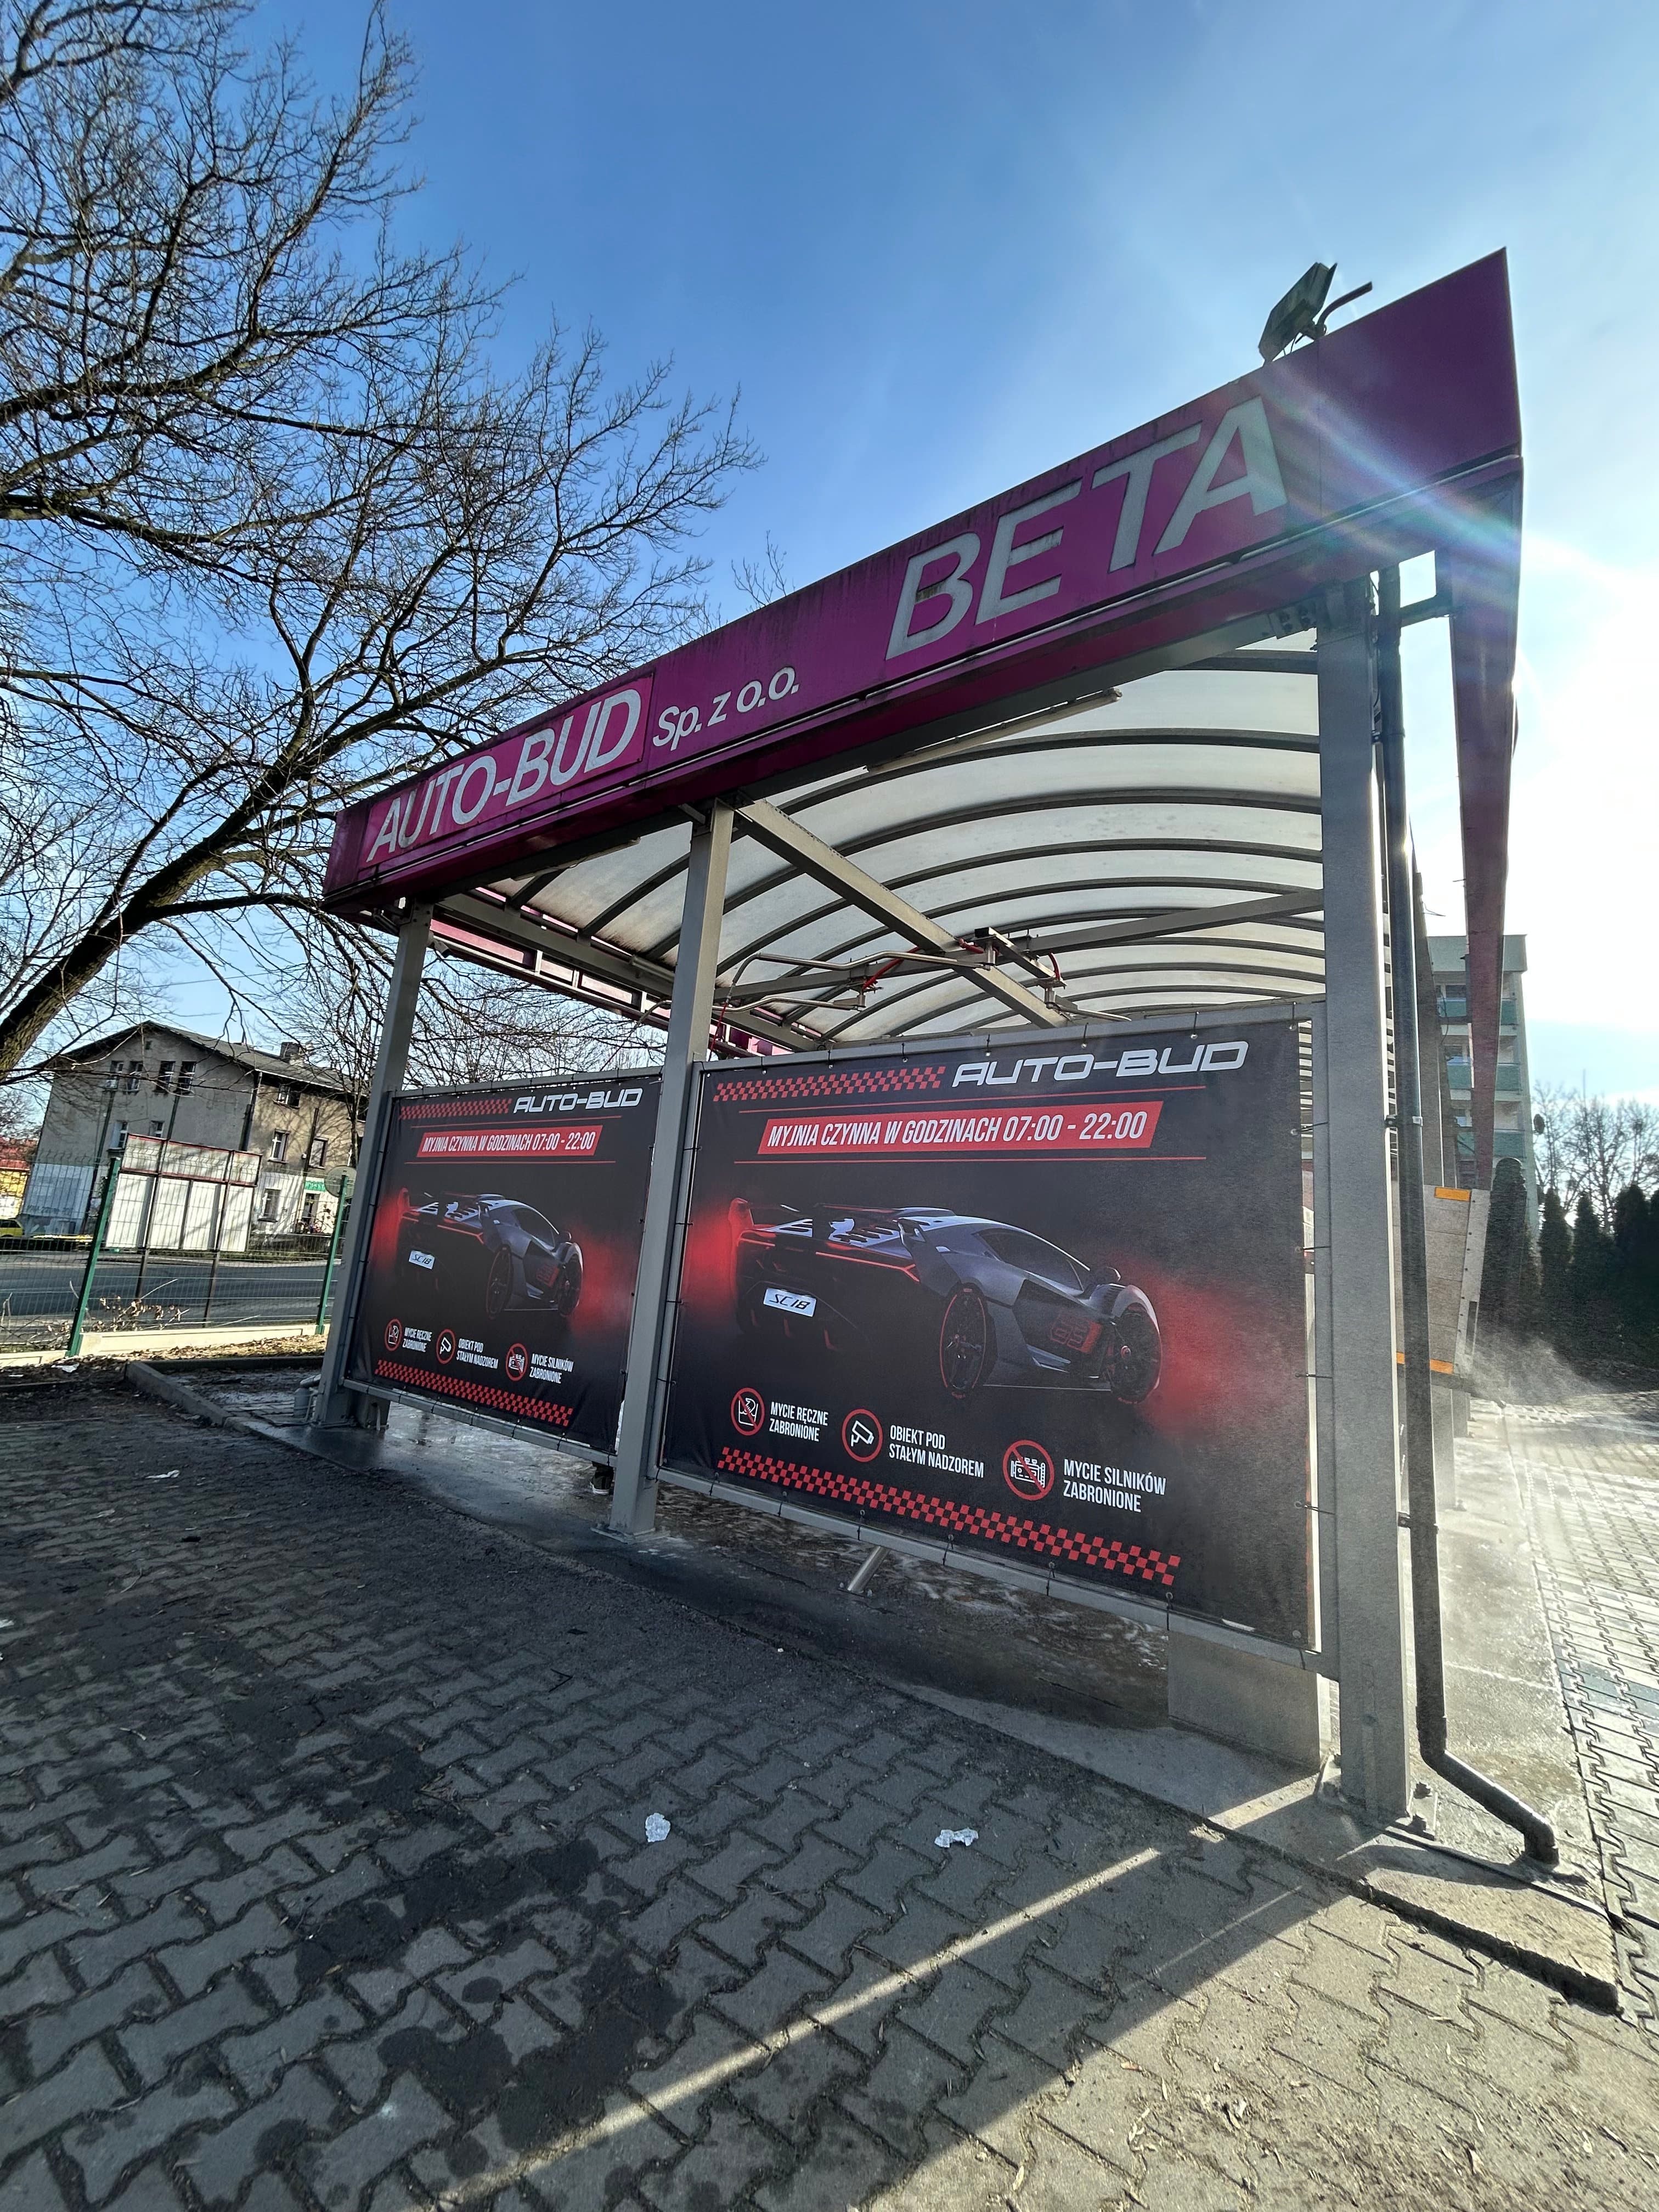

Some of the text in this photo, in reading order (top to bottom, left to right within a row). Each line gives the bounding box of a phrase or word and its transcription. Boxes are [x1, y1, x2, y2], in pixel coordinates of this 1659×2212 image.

[885, 396, 1288, 660] BETA
[366, 689, 642, 863] AUTO-BUD
[653, 706, 702, 751] Sp.
[707, 691, 732, 727] z
[952, 1041, 1249, 1087] AUTO-BUD
[513, 1088, 643, 1114] AUTO-BUD
[422, 1137, 449, 1153] MYJNIA
[448, 1136, 479, 1152] CZYNNA
[478, 1135, 489, 1151] W
[487, 1133, 533, 1151] GODZINACH
[532, 1132, 560, 1151] 07:00
[565, 1131, 596, 1150] 22:00
[767, 1125, 820, 1147] MYJNIA
[821, 1122, 881, 1146] CZYNNA
[883, 1121, 903, 1144] W
[902, 1117, 1002, 1144] GODZINACH
[1003, 1114, 1064, 1142] 07:00
[1079, 1111, 1148, 1140] 22:00
[473, 1354, 499, 1369] NADZOREM
[531, 1353, 574, 1373] MYCIE SILNIKÓW
[529, 1366, 562, 1384] ZABRONIONE
[770, 1401, 829, 1426] MYCIE RĘCZNE
[769, 1418, 820, 1442] ZABRONIONE
[890, 1425, 946, 1450] OBIEKT POD
[889, 1443, 984, 1479] STAŁYM NADZOREM
[1063, 1458, 1166, 1496] MYCIE SILNIKÓW
[1063, 1480, 1142, 1513] ZABRONIONE
